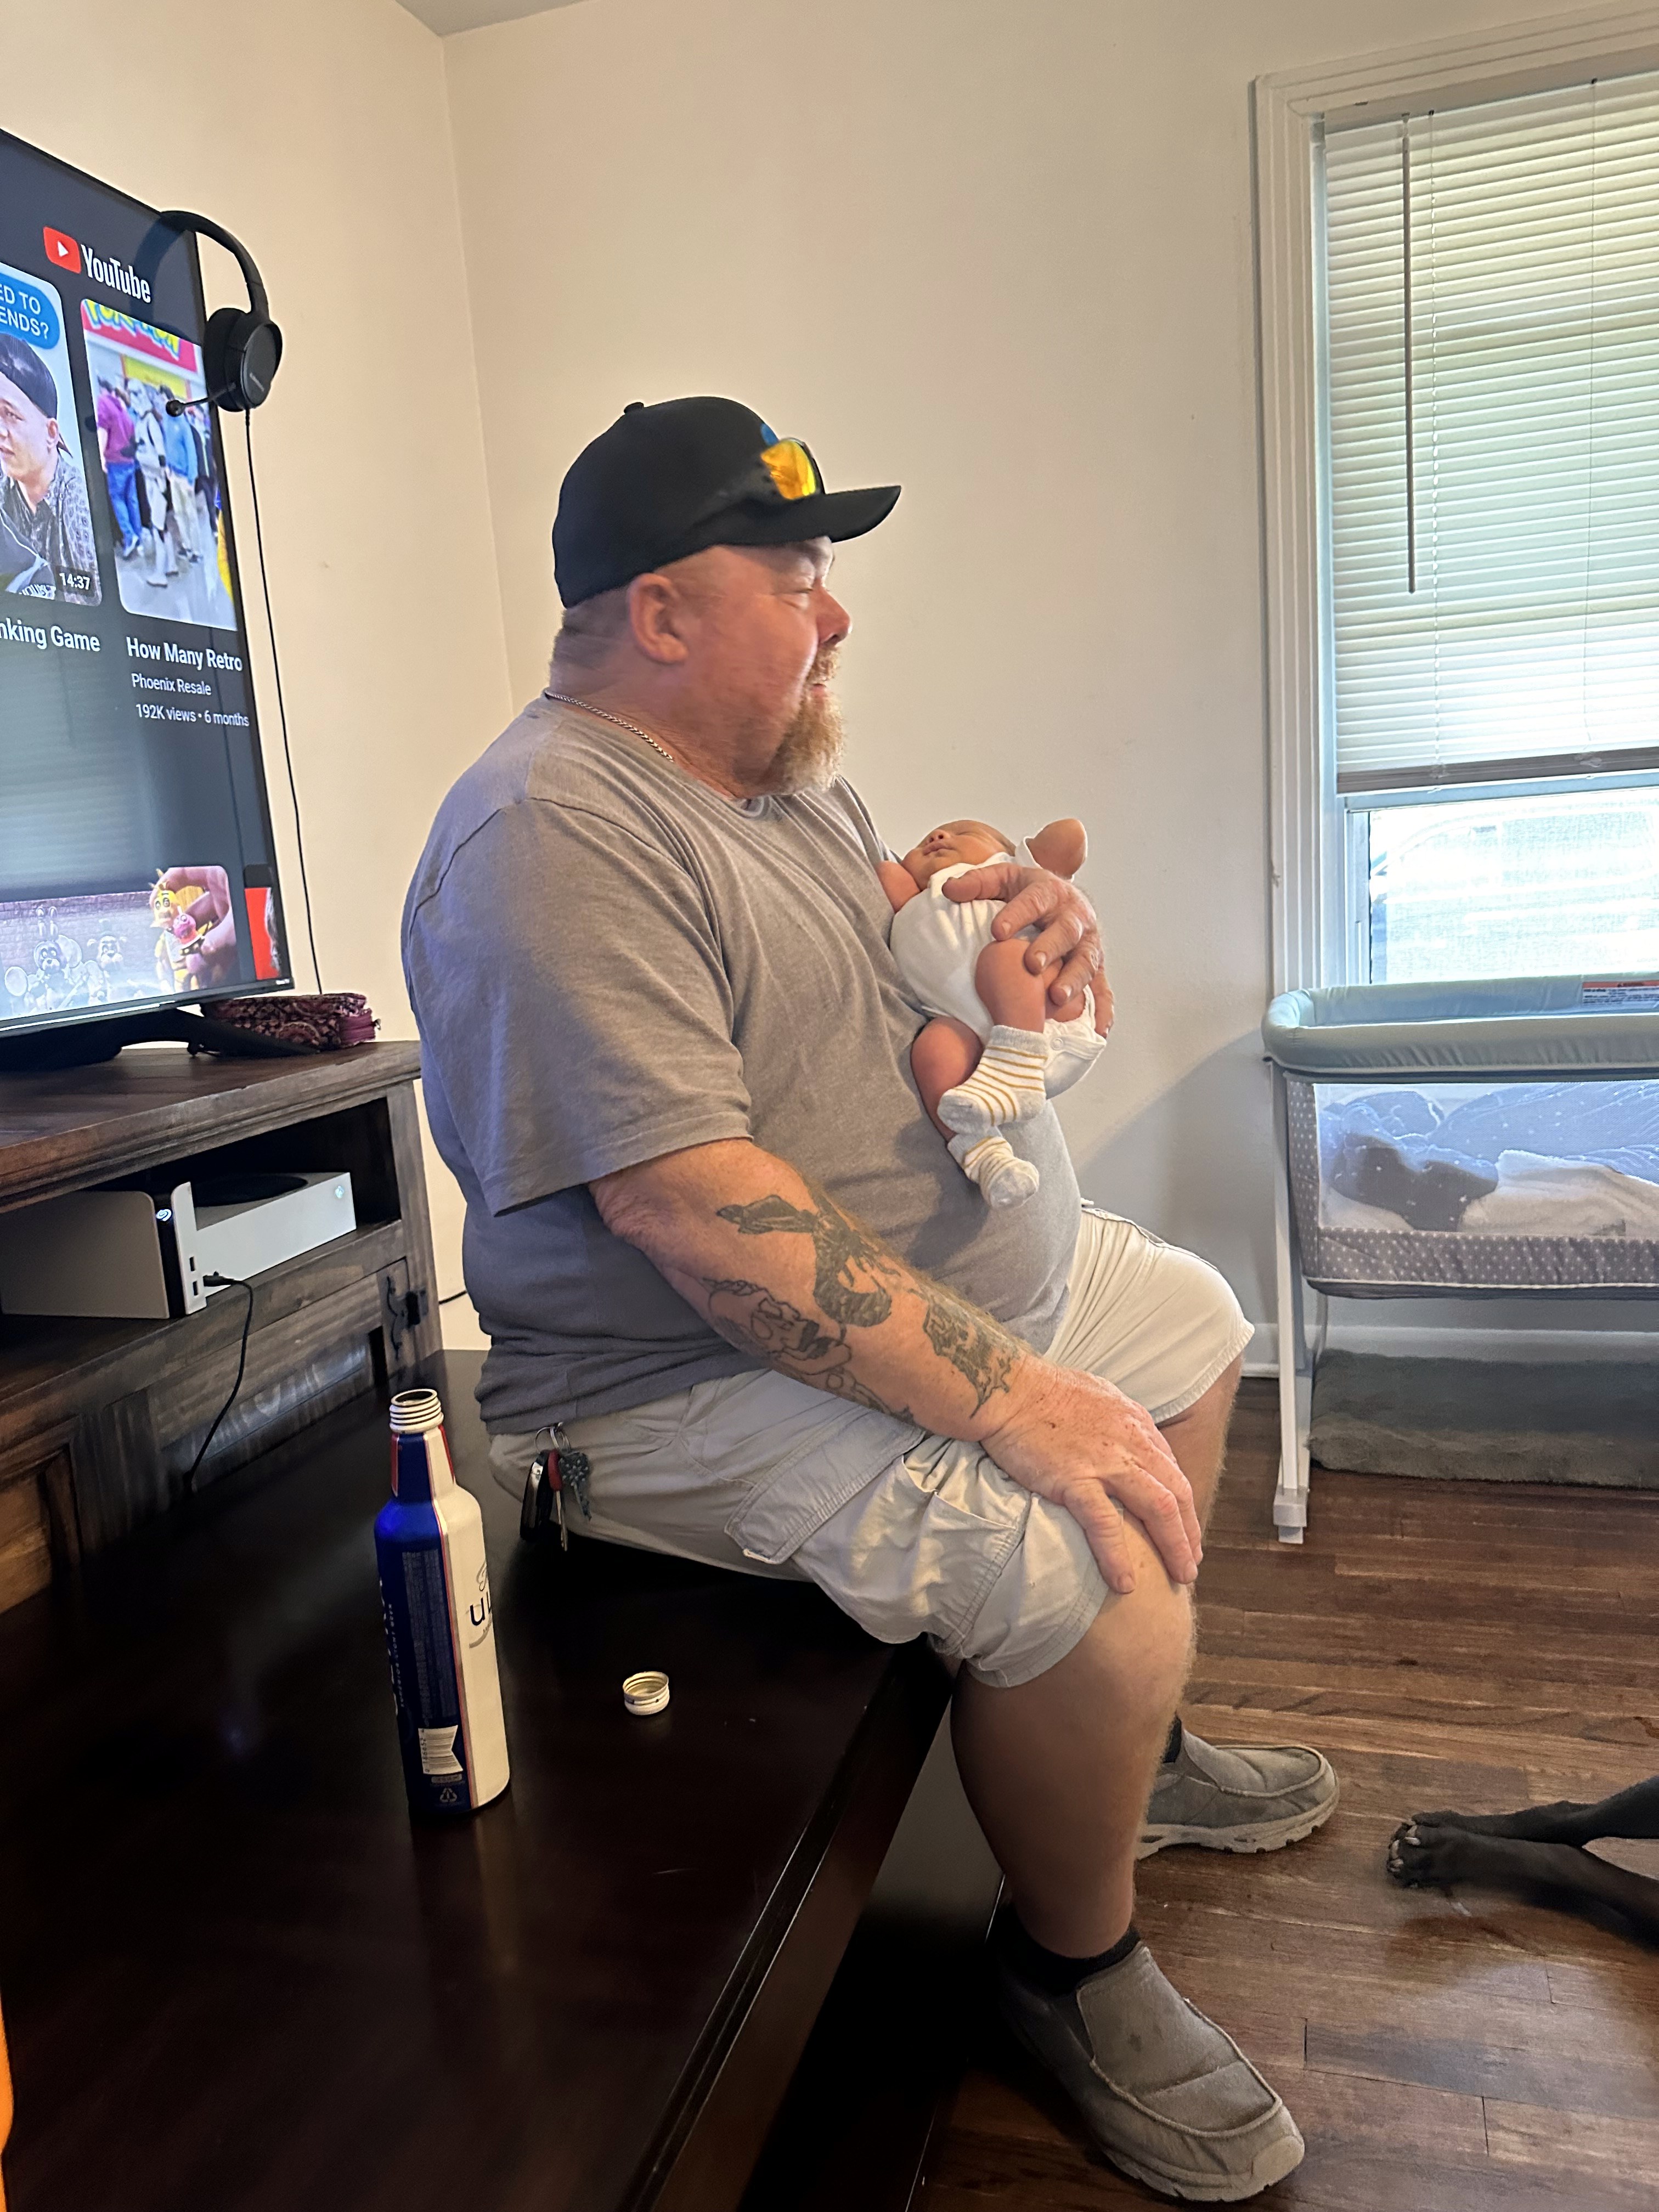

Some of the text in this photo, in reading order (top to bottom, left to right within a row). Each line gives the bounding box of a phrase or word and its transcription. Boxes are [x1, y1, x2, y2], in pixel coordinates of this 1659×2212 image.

[81, 244, 151, 303] YouTube
[18, 291, 41, 315] TO
[0, 306, 49, 340] ENDS?
[59, 573, 91, 590] 14:37
[0, 617, 100, 652] nking Game
[126, 636, 243, 672] How Many Retro
[131, 673, 212, 696] Phoenix Resale
[136, 703, 250, 727] 192K views 6 months
